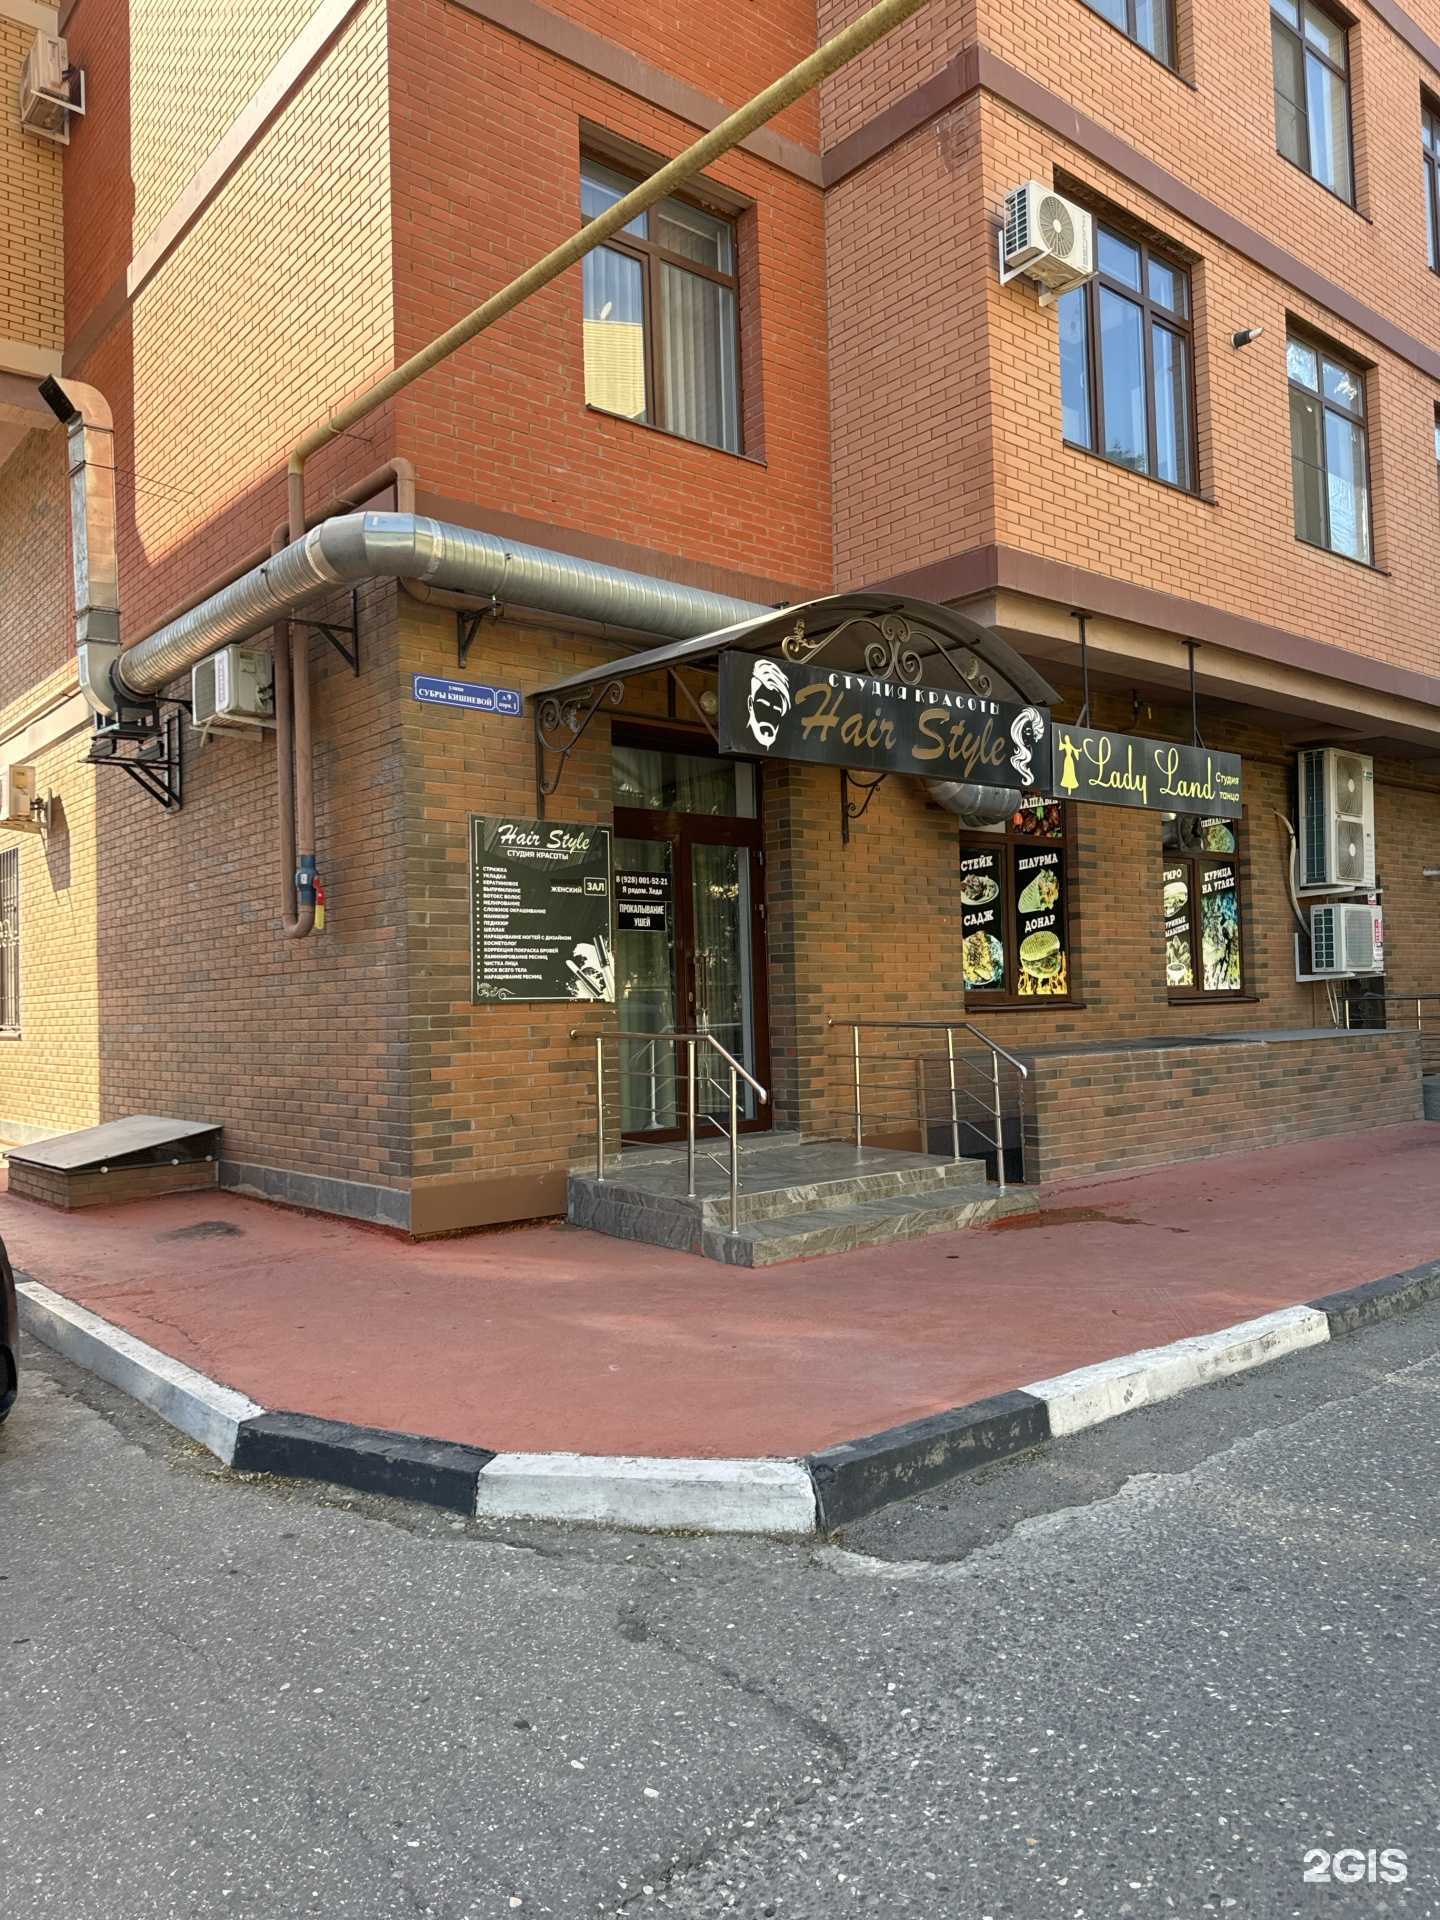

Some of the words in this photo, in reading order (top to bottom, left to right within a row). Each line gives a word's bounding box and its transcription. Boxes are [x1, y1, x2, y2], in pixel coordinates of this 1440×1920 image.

[418, 688, 446, 699] СУБРЫ
[828, 673, 907, 700] СТУДИЯ
[915, 689, 999, 716] КРАСОТЫ
[795, 683, 896, 749] Hair
[912, 708, 1007, 778] Style
[1083, 736, 1147, 805] Lady
[1154, 747, 1215, 800] Land
[1215, 772, 1240, 786] Студия
[498, 824, 540, 845] Hair
[546, 830, 590, 854] Style
[507, 850, 535, 858] СТУДИЯ
[536, 851, 569, 860] КРАСОТЫ
[961, 855, 993, 871] СТЕЙК
[1019, 853, 1058, 870] ШАУРМА
[587, 882, 605, 891] ЗАЛ
[1202, 883, 1212, 894] НА
[619, 903, 664, 914] ПРОКАЛЫВАНИЕ
[633, 917, 650, 927] УШЕЙ
[963, 910, 994, 926] САДЖ
[1025, 915, 1055, 933] ДОНАР
